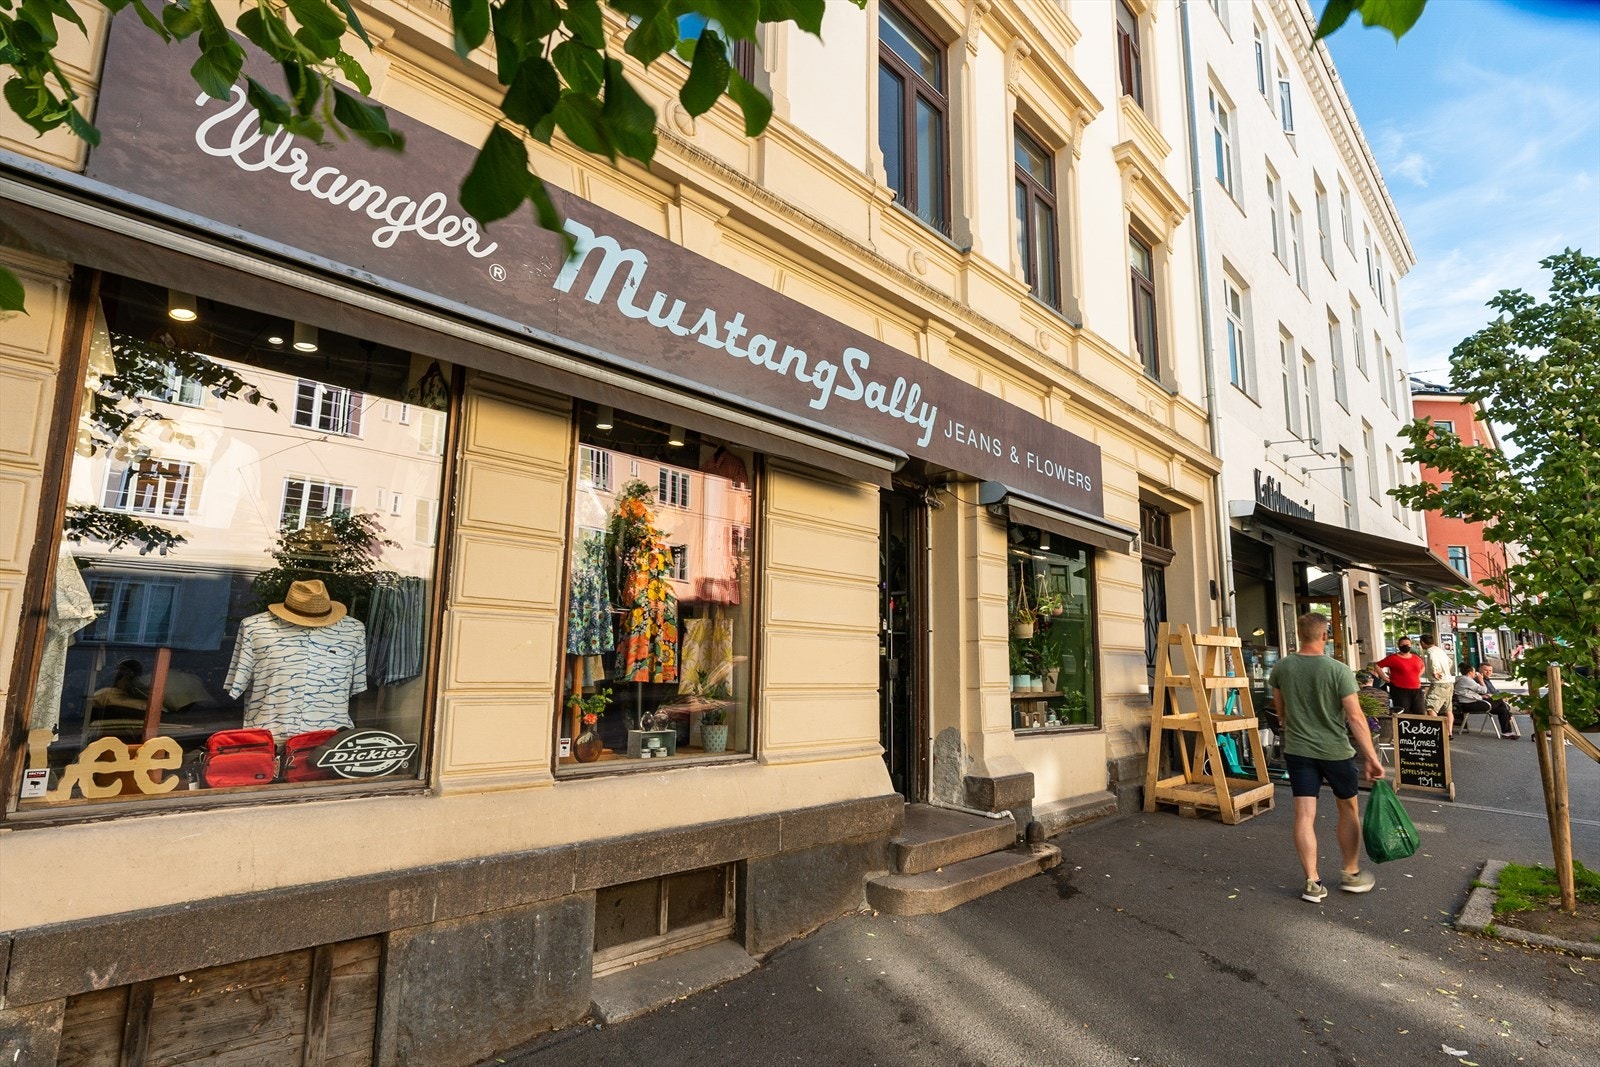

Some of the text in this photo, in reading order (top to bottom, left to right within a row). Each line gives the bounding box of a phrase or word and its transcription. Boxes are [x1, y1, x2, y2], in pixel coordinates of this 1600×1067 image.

[195, 84, 498, 258] Wrangler
[944, 420, 1002, 457] JEANS
[1010, 445, 1020, 465] &
[1027, 452, 1092, 492] FLOWERS
[1398, 720, 1441, 736] Reker
[1399, 736, 1436, 750] majones
[329, 747, 408, 762] Dickies
